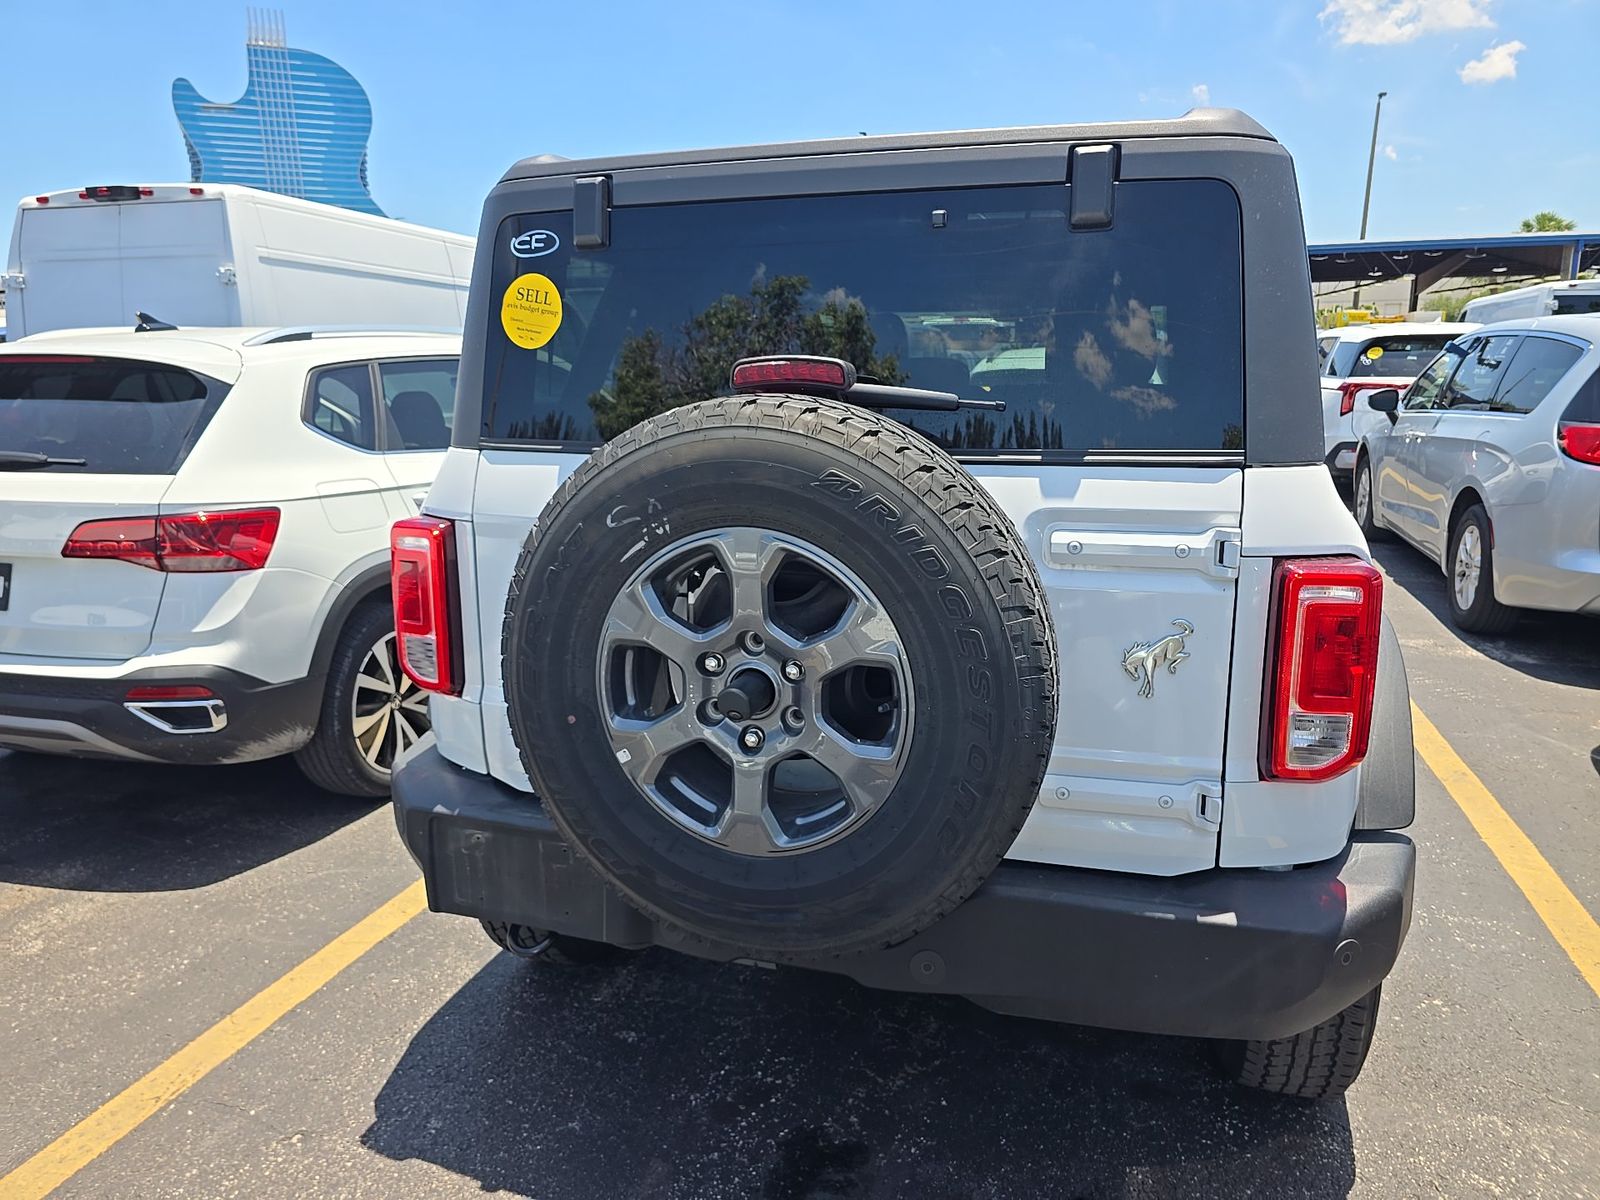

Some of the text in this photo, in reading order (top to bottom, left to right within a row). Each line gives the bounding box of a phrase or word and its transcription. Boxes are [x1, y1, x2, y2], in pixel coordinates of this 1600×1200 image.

[516, 287, 553, 306] SELL
[519, 303, 540, 314] budget
[810, 467, 994, 857] BRIDGESTONE
